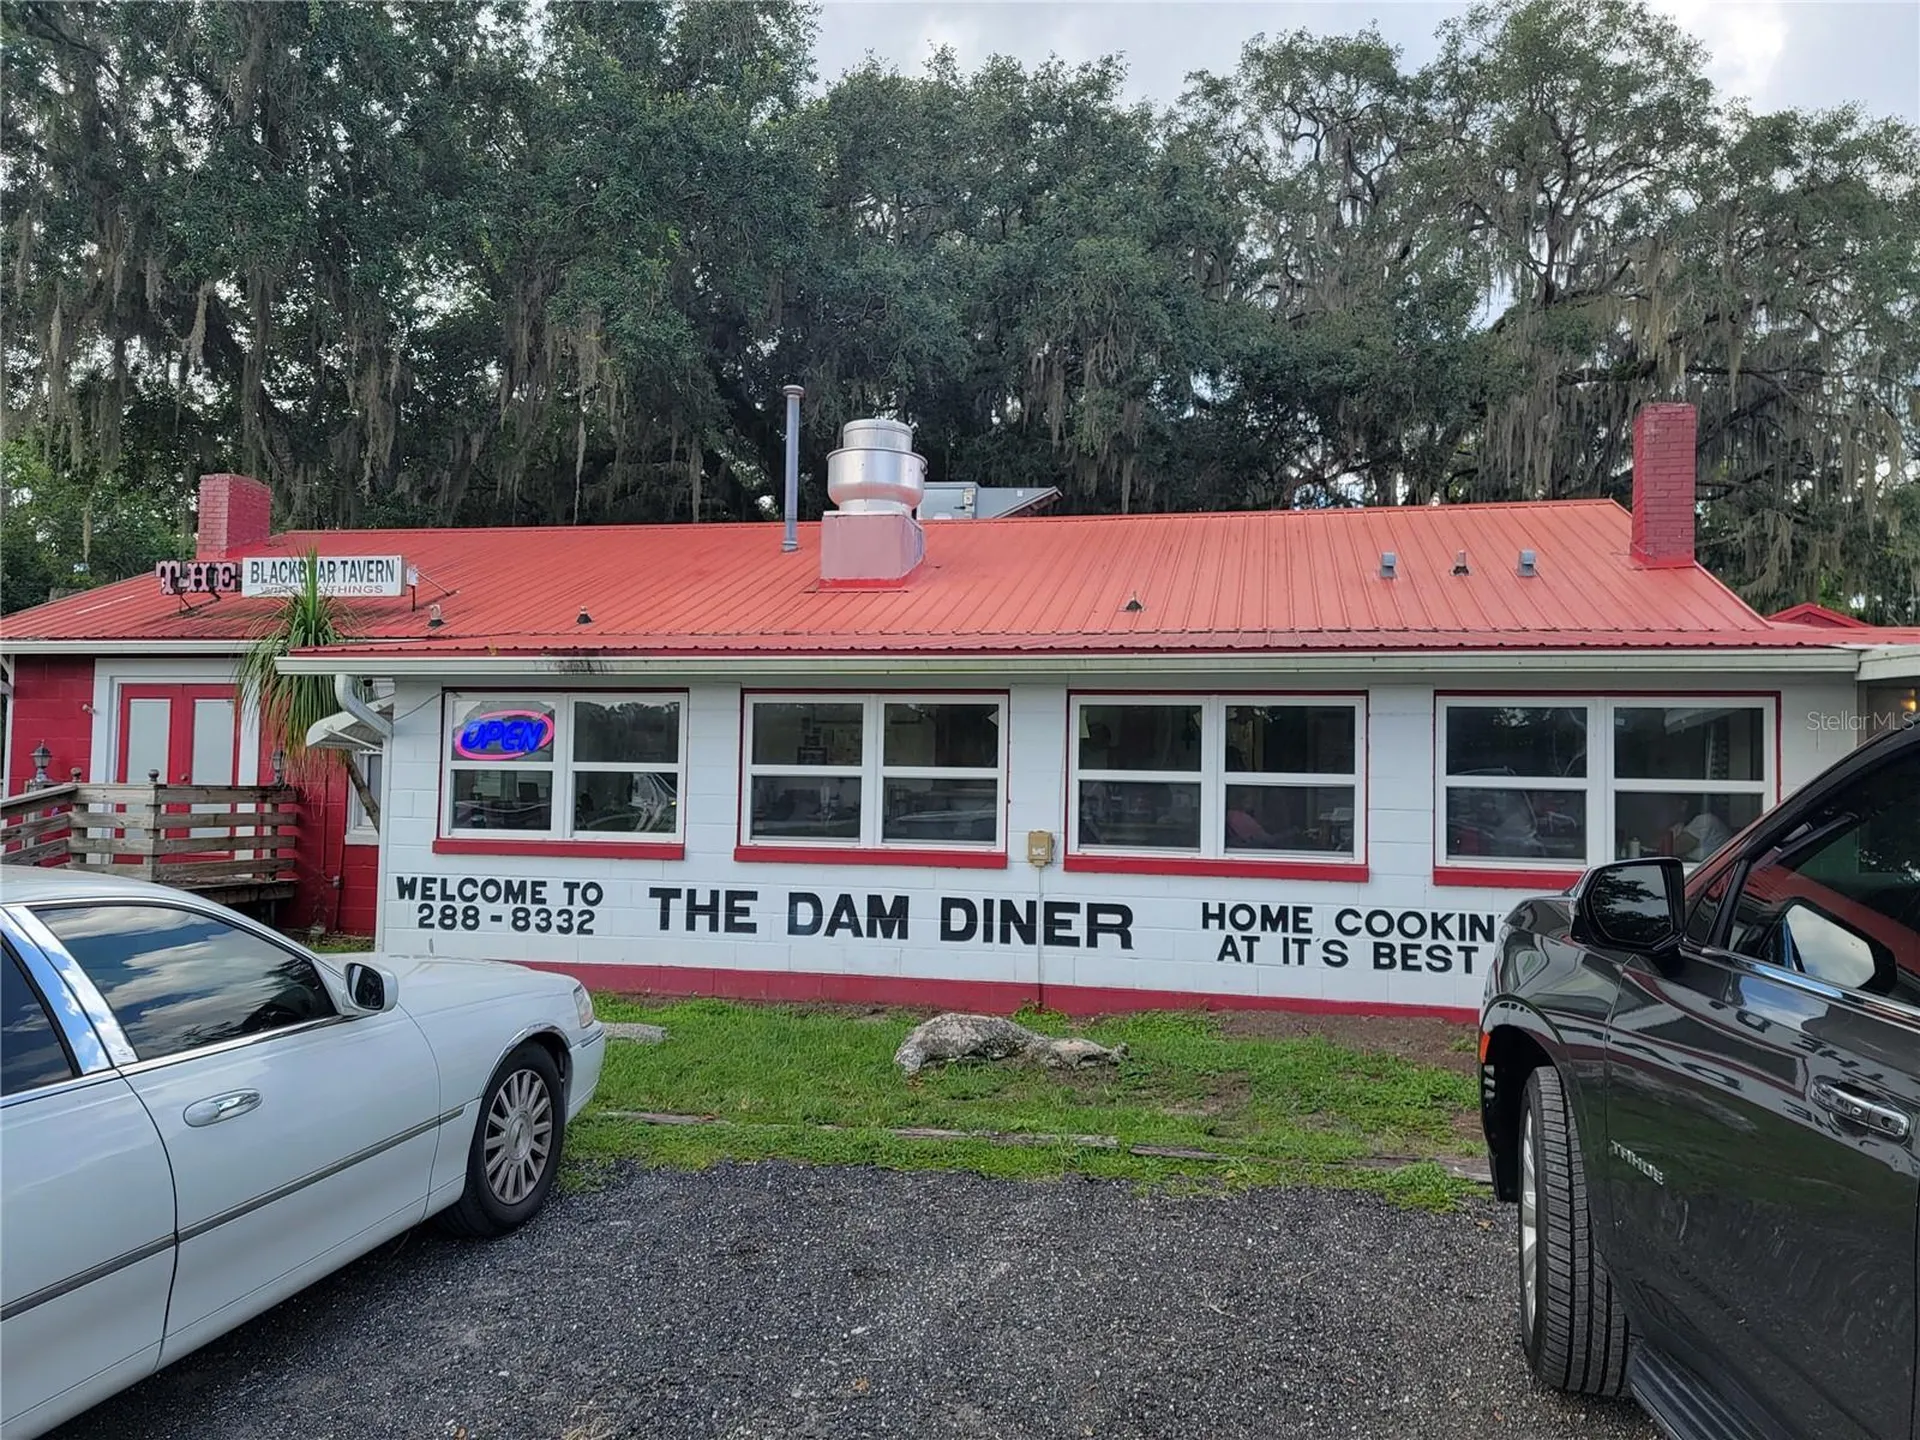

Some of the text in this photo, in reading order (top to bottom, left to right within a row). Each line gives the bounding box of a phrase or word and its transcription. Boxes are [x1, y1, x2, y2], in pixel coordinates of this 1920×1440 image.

[156, 560, 236, 595] THE
[250, 559, 395, 583] BLACKBAR TAVERN
[461, 719, 545, 752] OPEN
[396, 876, 604, 907] WELCOME TO
[648, 887, 1135, 950] THE DAM DINER
[1201, 902, 1313, 934] HOME
[1217, 934, 1479, 974] AT IT'S BEST
